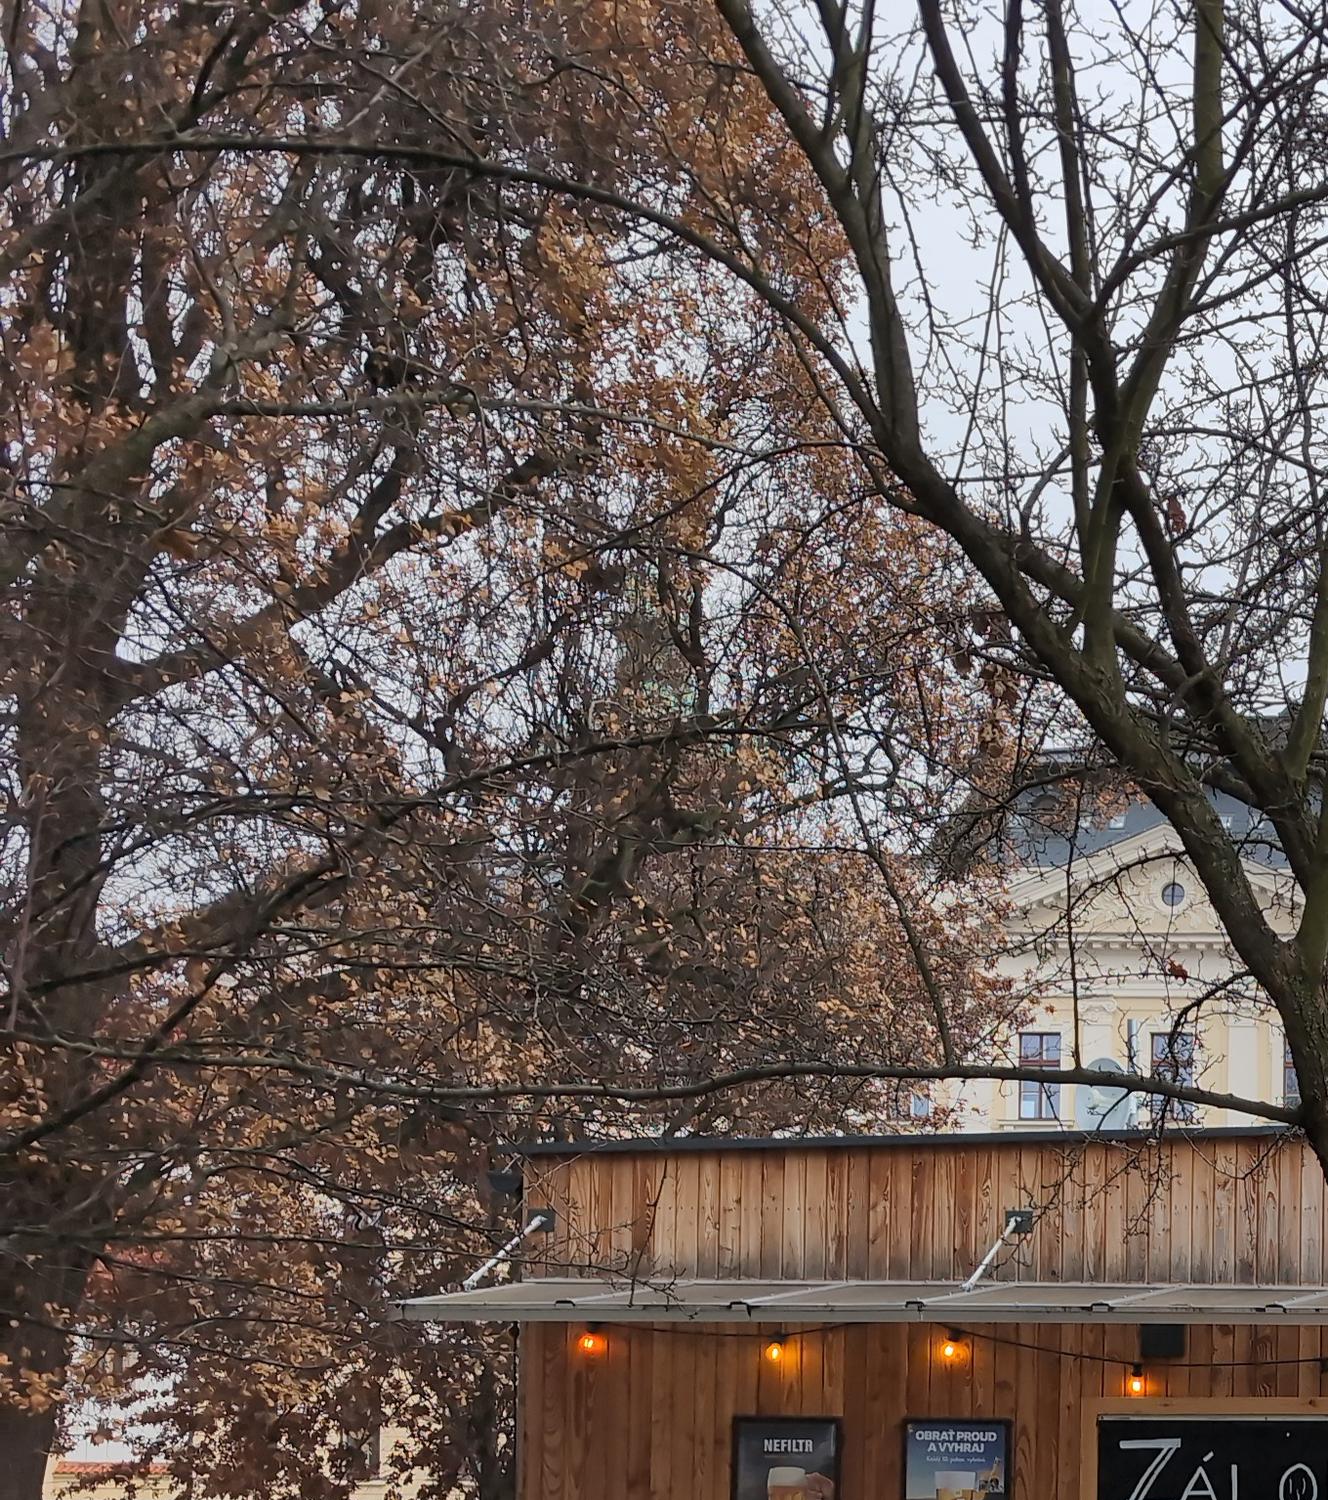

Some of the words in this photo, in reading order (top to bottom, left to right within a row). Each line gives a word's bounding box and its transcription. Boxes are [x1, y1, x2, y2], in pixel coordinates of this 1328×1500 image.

[915, 1428, 955, 1441] OBRAŤ
[956, 1431, 997, 1442] PROUD
[764, 1439, 813, 1452] NEFILTR
[927, 1442, 937, 1452] A
[938, 1442, 985, 1453] VYHRAJ
